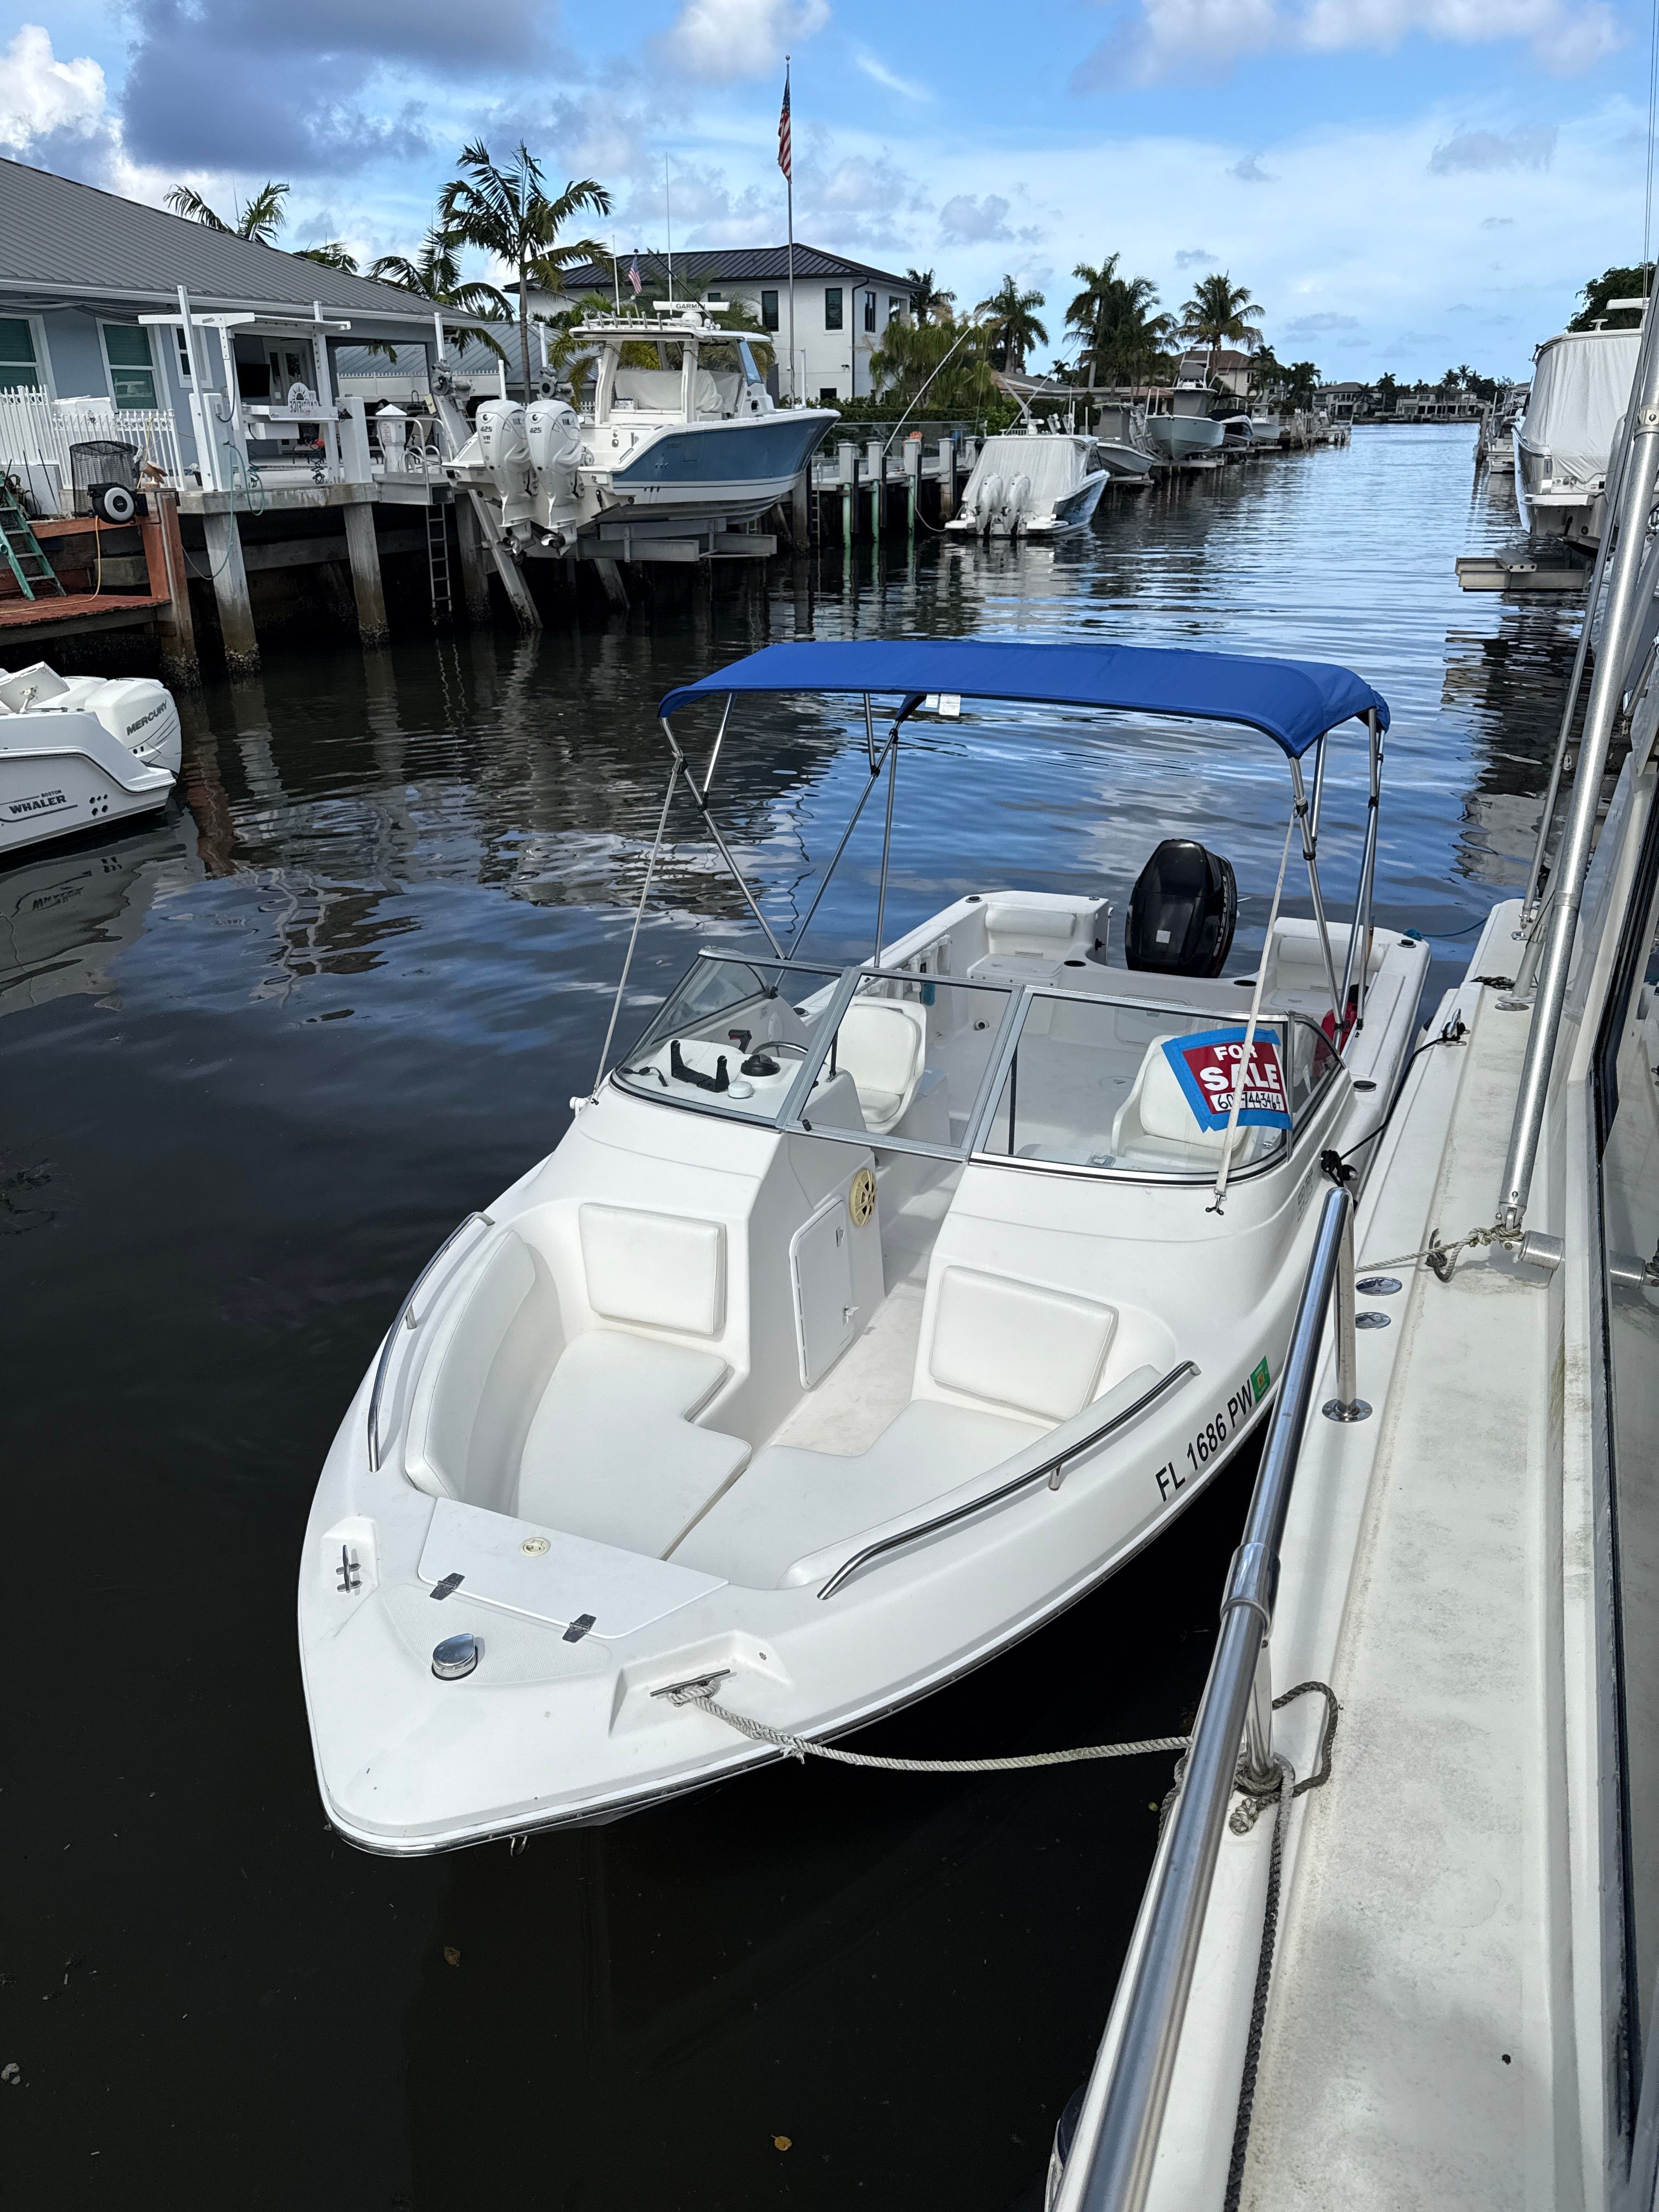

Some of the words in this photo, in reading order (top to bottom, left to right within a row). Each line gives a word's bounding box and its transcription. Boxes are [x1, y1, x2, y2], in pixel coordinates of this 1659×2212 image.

[127, 699, 167, 736] MERCURY
[9, 794, 67, 814] WHALER
[41, 789, 62, 798] BOSTON
[1214, 1045, 1258, 1060] FOR
[1200, 1063, 1280, 1091] SALE
[1155, 1462, 1186, 1502] FL
[1187, 1412, 1226, 1471] 1686
[1227, 1379, 1252, 1429] PW
